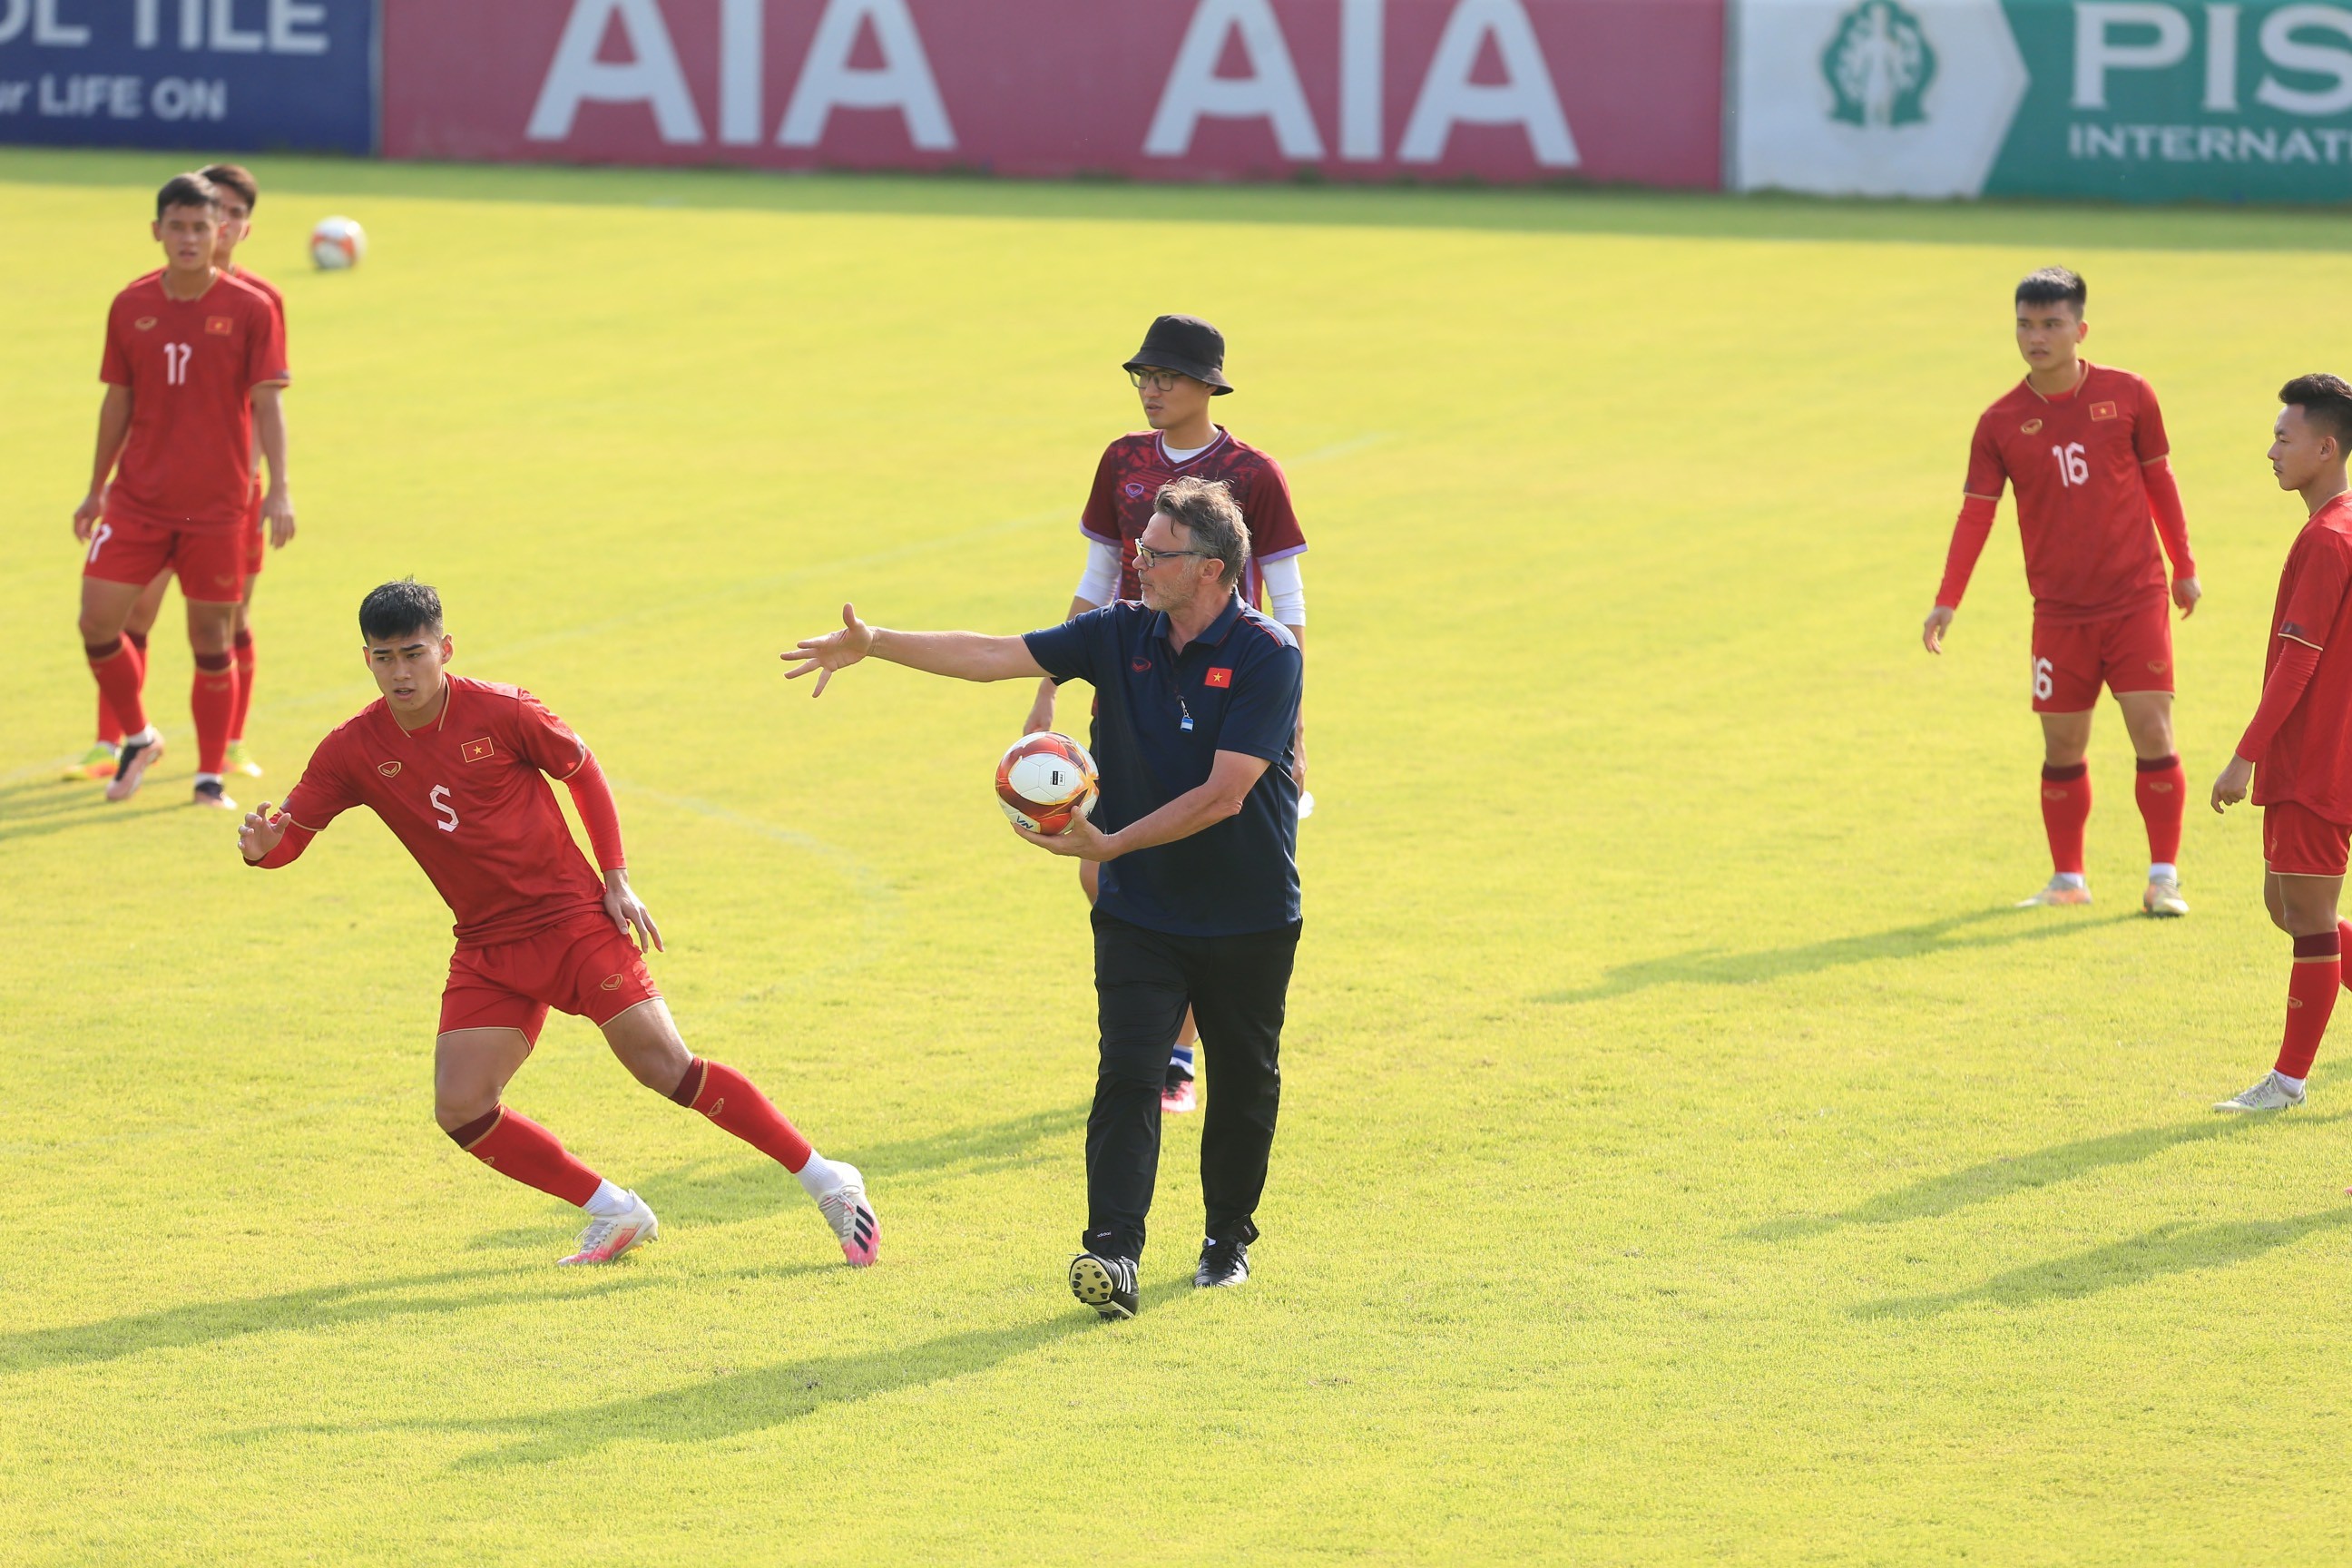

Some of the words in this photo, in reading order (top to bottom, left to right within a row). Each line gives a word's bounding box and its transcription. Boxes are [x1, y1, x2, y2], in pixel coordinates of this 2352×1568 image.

[524, 0, 959, 151] AIA
[2070, 2, 2352, 116] PIS
[39, 73, 142, 119] LIFE
[150, 75, 226, 122] ON
[1142, 0, 1582, 168] AIA
[2068, 122, 2352, 164] INTERNAT
[163, 342, 192, 386] 17
[2052, 441, 2089, 488] 16
